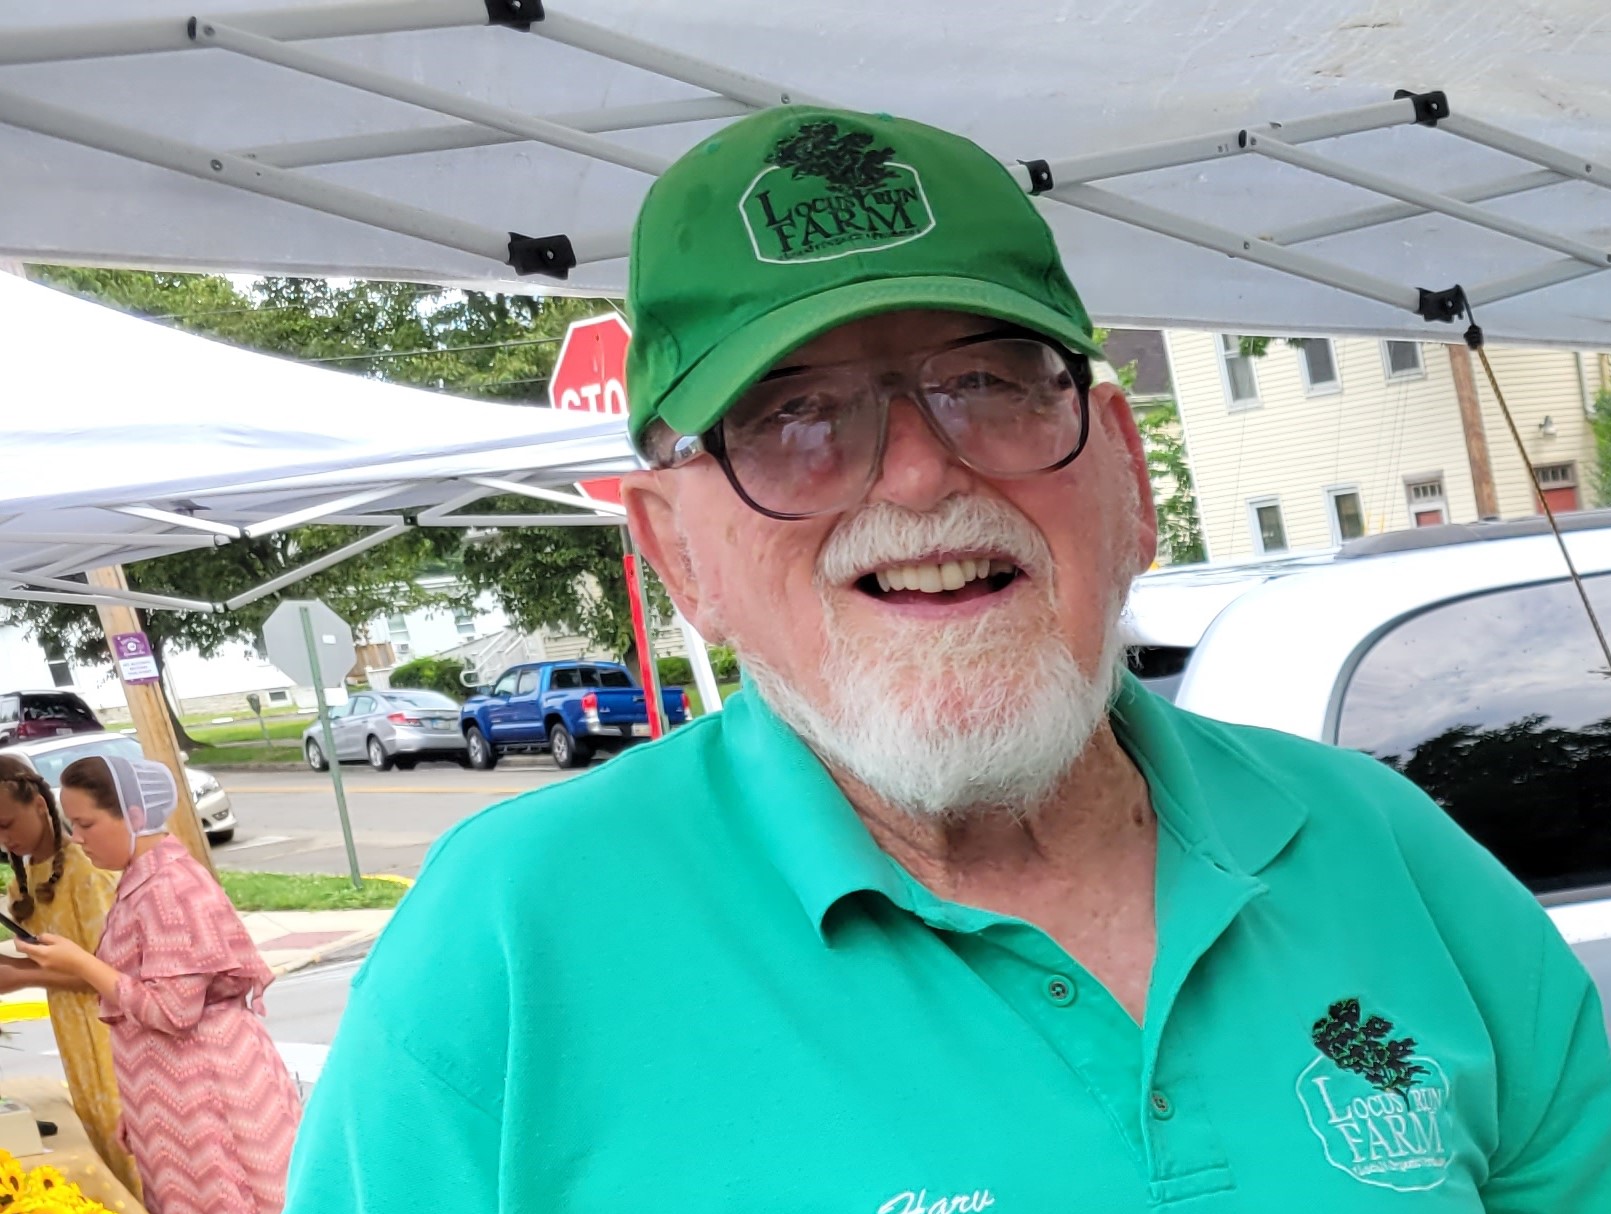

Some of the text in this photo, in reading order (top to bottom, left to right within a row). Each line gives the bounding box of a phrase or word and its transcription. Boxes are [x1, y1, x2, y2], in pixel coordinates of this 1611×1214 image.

[774, 202, 917, 253] FARM
[1409, 1088, 1441, 1113] RUN
[1335, 1111, 1445, 1163] FARM
